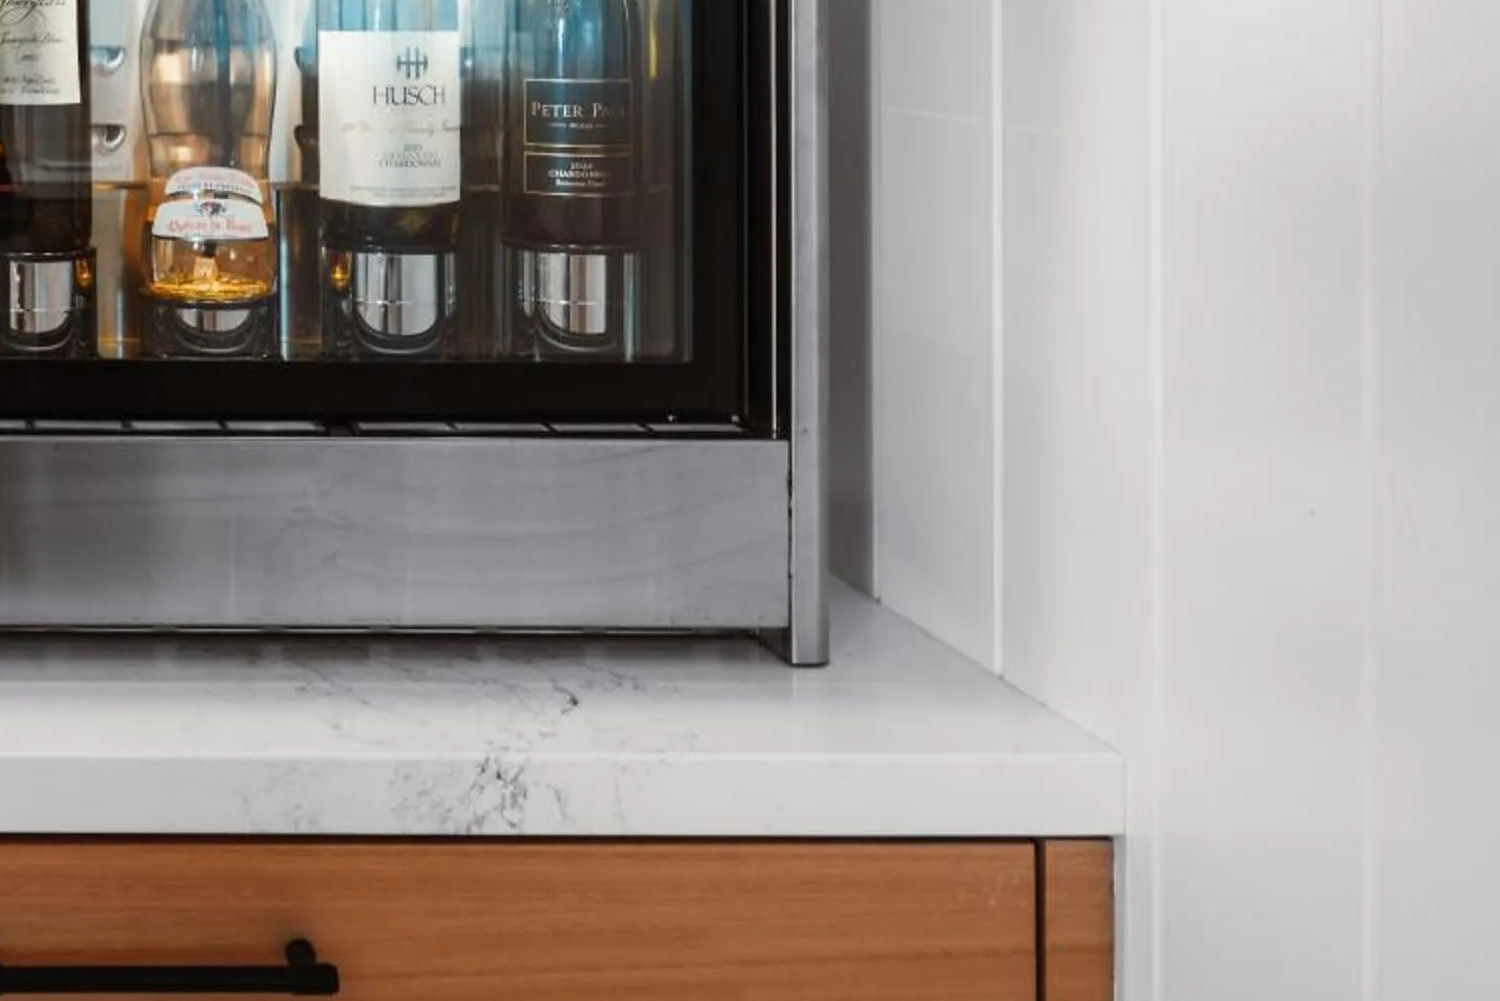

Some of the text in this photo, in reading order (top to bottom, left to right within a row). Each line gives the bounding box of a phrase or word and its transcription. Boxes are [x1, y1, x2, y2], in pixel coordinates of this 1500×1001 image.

[372, 86, 446, 106] HUSCH
[531, 102, 625, 118] PETER PA
